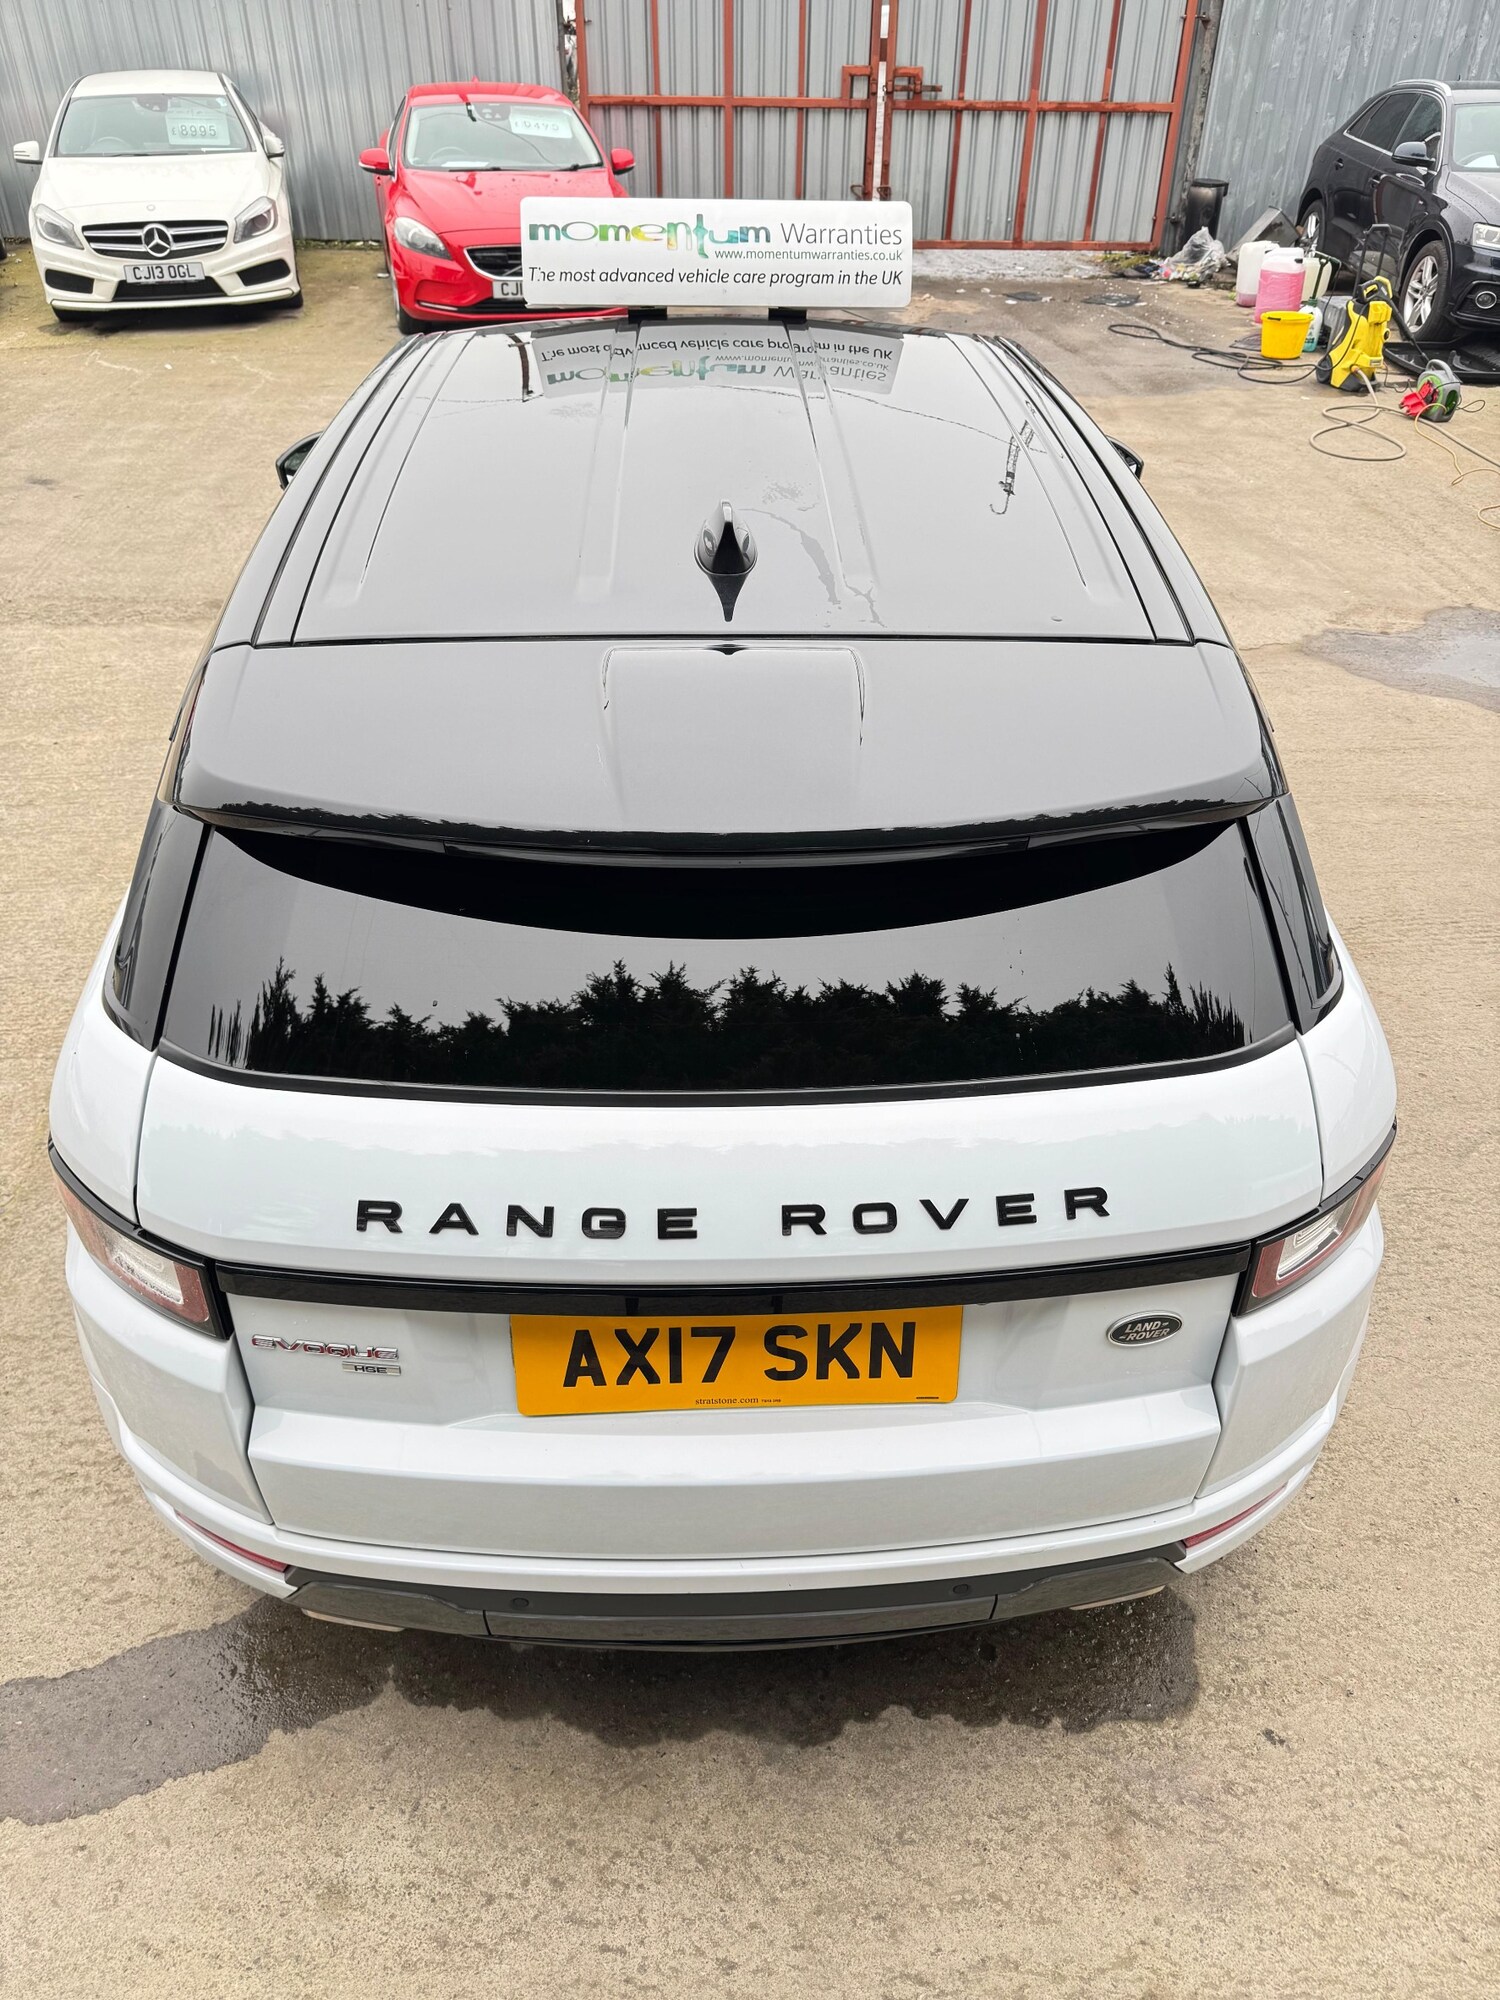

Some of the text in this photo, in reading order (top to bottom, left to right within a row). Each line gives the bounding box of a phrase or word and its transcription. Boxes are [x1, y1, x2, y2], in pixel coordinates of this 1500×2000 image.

[528, 213, 903, 259] momentum Warranties
[714, 249, 903, 261] www.momentumwarranties.co.uk
[132, 263, 196, 280] CJ13 OGL
[528, 266, 904, 288] The most advanced vehicle care program in the UK
[356, 1186, 1111, 1240] RANGE ROVER
[1124, 1320, 1162, 1334] LAND
[1126, 1328, 1171, 1341] ROVER
[251, 1333, 400, 1361] EVOQUE
[562, 1321, 917, 1388] AX17 SKN
[353, 1365, 388, 1374] HSE
[695, 1396, 759, 1405] stratstone.com
